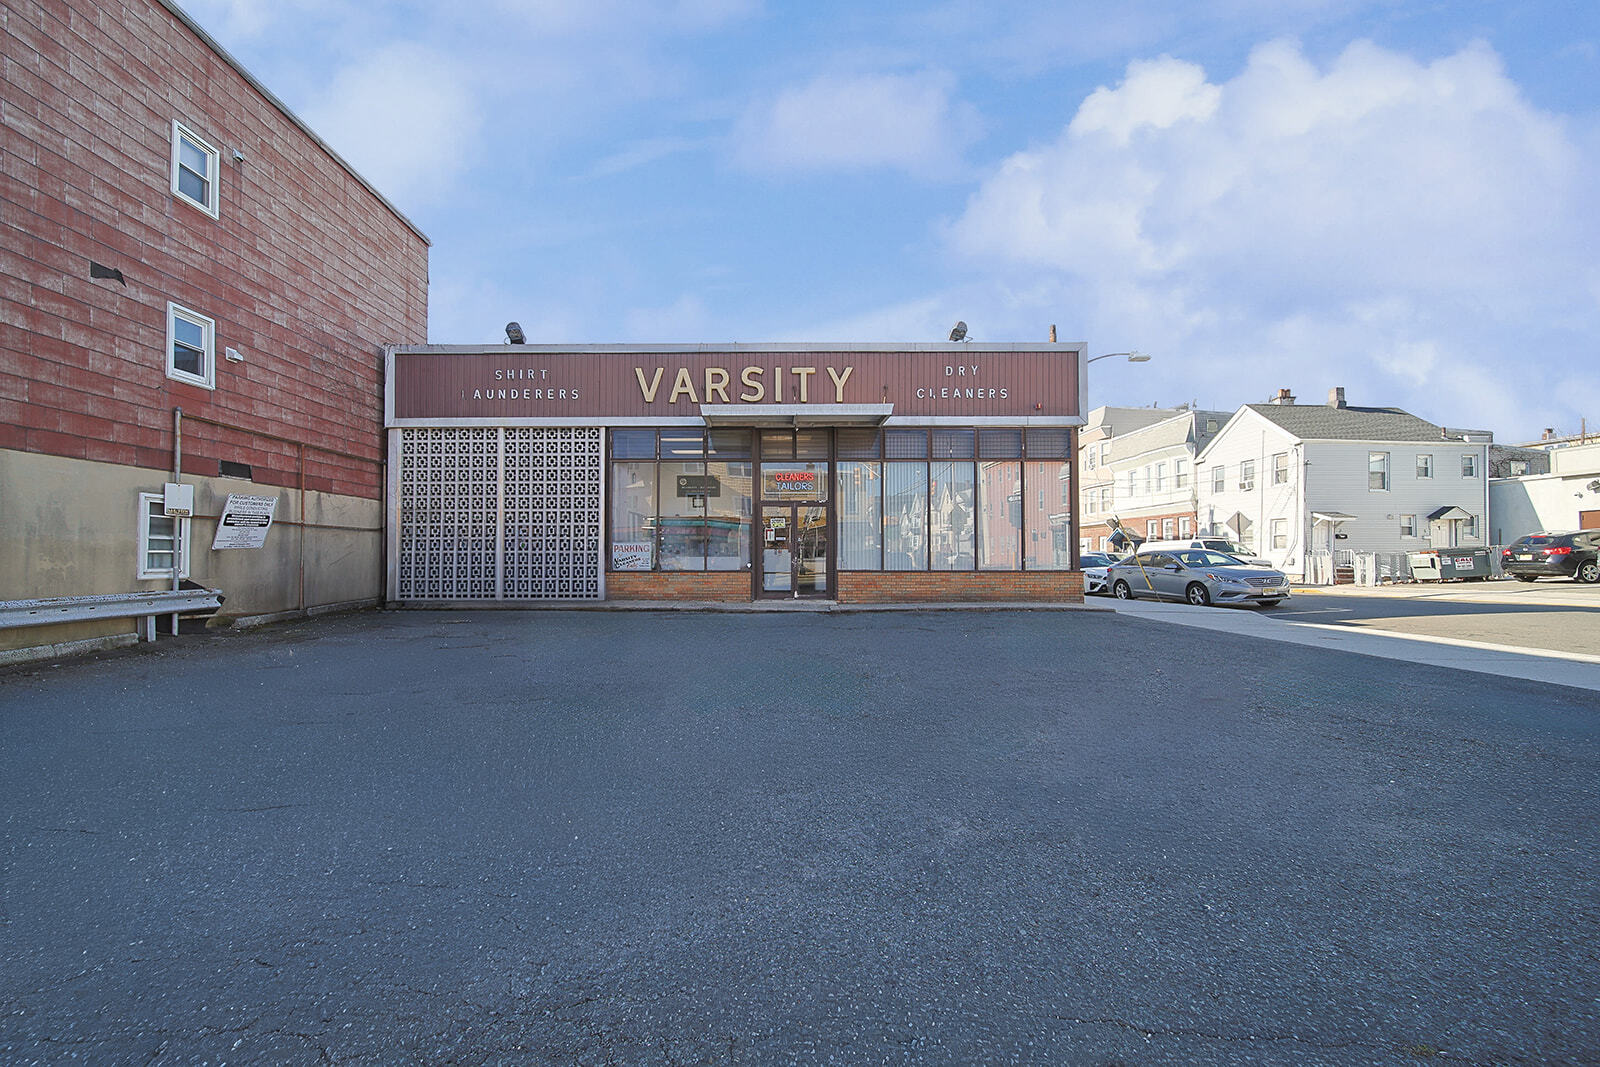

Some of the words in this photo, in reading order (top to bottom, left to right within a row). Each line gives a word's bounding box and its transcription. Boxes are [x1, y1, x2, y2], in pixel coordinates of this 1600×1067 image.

[495, 369, 548, 380] SHIRT
[945, 365, 979, 376] DRY
[635, 366, 854, 403] VARSITY
[916, 387, 1008, 399] CLEANERS
[775, 472, 815, 481] CLEANERS
[776, 481, 814, 491] TAILORS
[614, 544, 650, 552] PARKING
[614, 554, 637, 564] VARSITY
